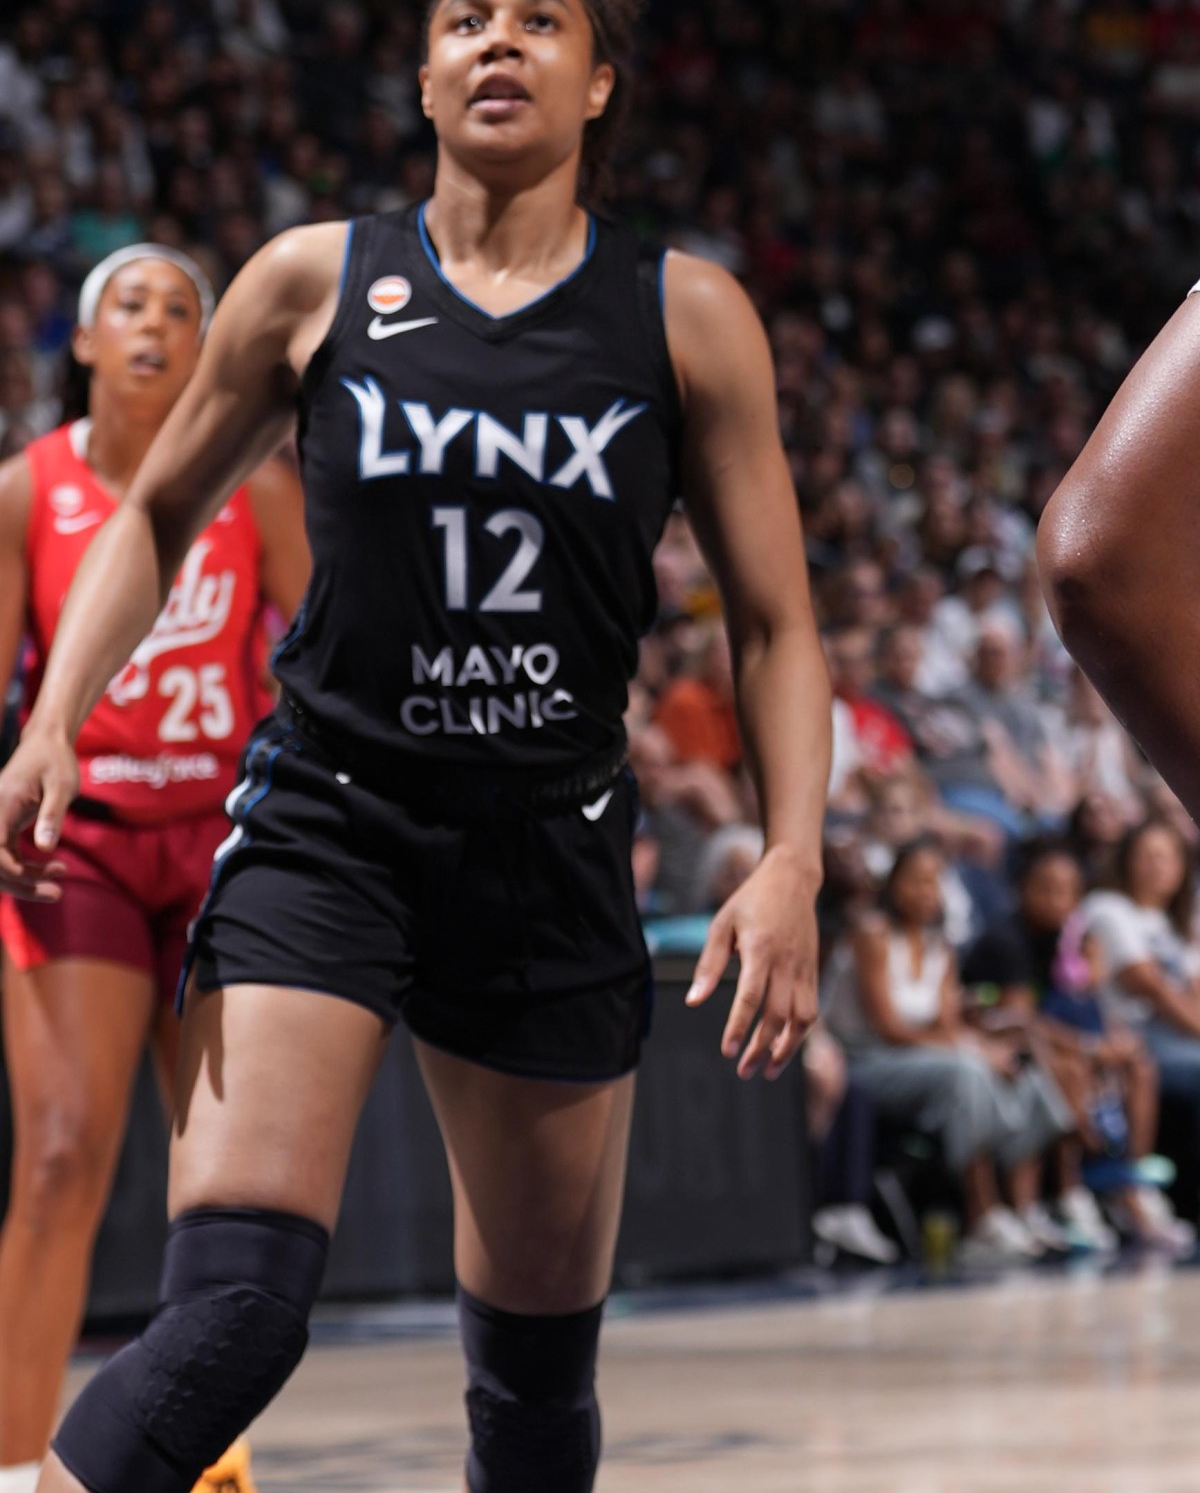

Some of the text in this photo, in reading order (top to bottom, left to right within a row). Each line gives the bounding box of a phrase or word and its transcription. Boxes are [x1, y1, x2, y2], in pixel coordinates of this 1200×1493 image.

[339, 374, 648, 502] LYNX
[431, 506, 545, 612] 12
[157, 663, 235, 742] 25
[410, 643, 560, 687] MAYO
[399, 688, 578, 736] CLINIC
